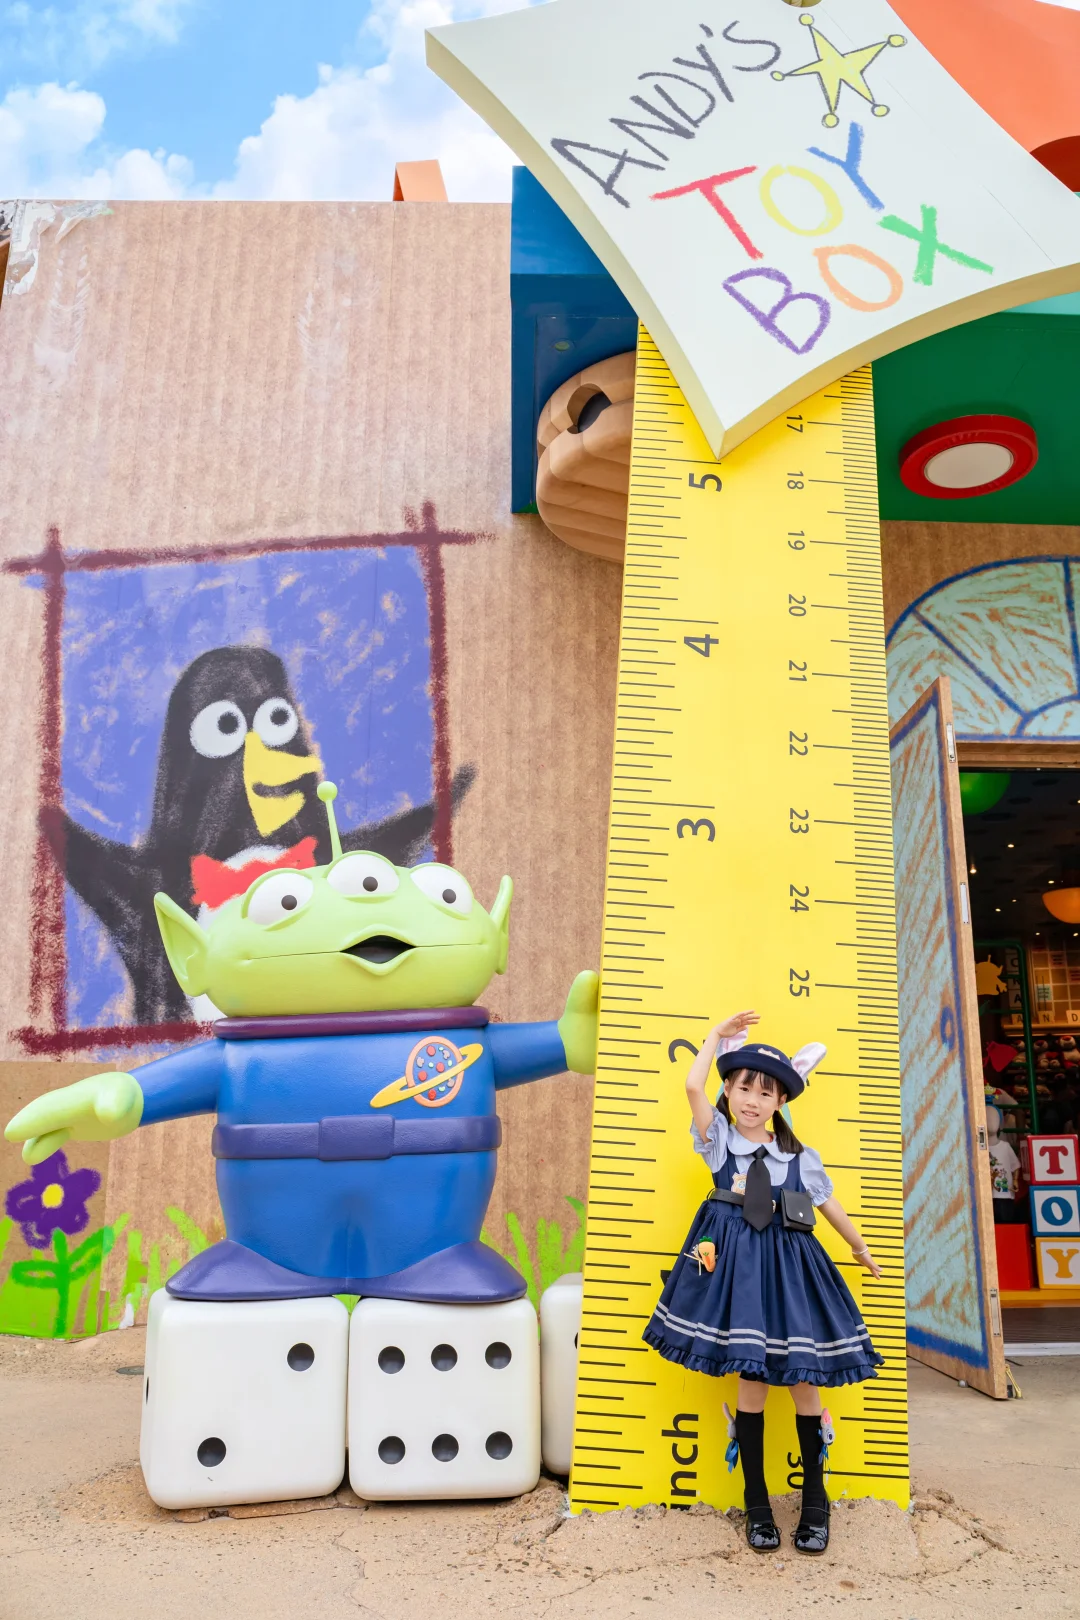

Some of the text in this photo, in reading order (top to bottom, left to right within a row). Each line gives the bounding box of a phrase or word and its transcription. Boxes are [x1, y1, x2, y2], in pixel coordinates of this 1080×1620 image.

[550, 20, 781, 209] ANDY'S
[649, 121, 885, 260] TOY
[722, 204, 994, 355] BOX
[786, 414, 803, 433] 17
[688, 472, 722, 492] 5
[786, 470, 804, 490] 18
[787, 530, 806, 551] 19
[788, 594, 807, 617] 20
[683, 633, 719, 658] 4
[788, 660, 808, 682] 21
[789, 731, 808, 756] 22
[676, 818, 716, 843] 3
[790, 808, 809, 834] 23
[790, 884, 810, 912] 24
[790, 968, 810, 997] 25
[786, 1452, 804, 1490] 30
